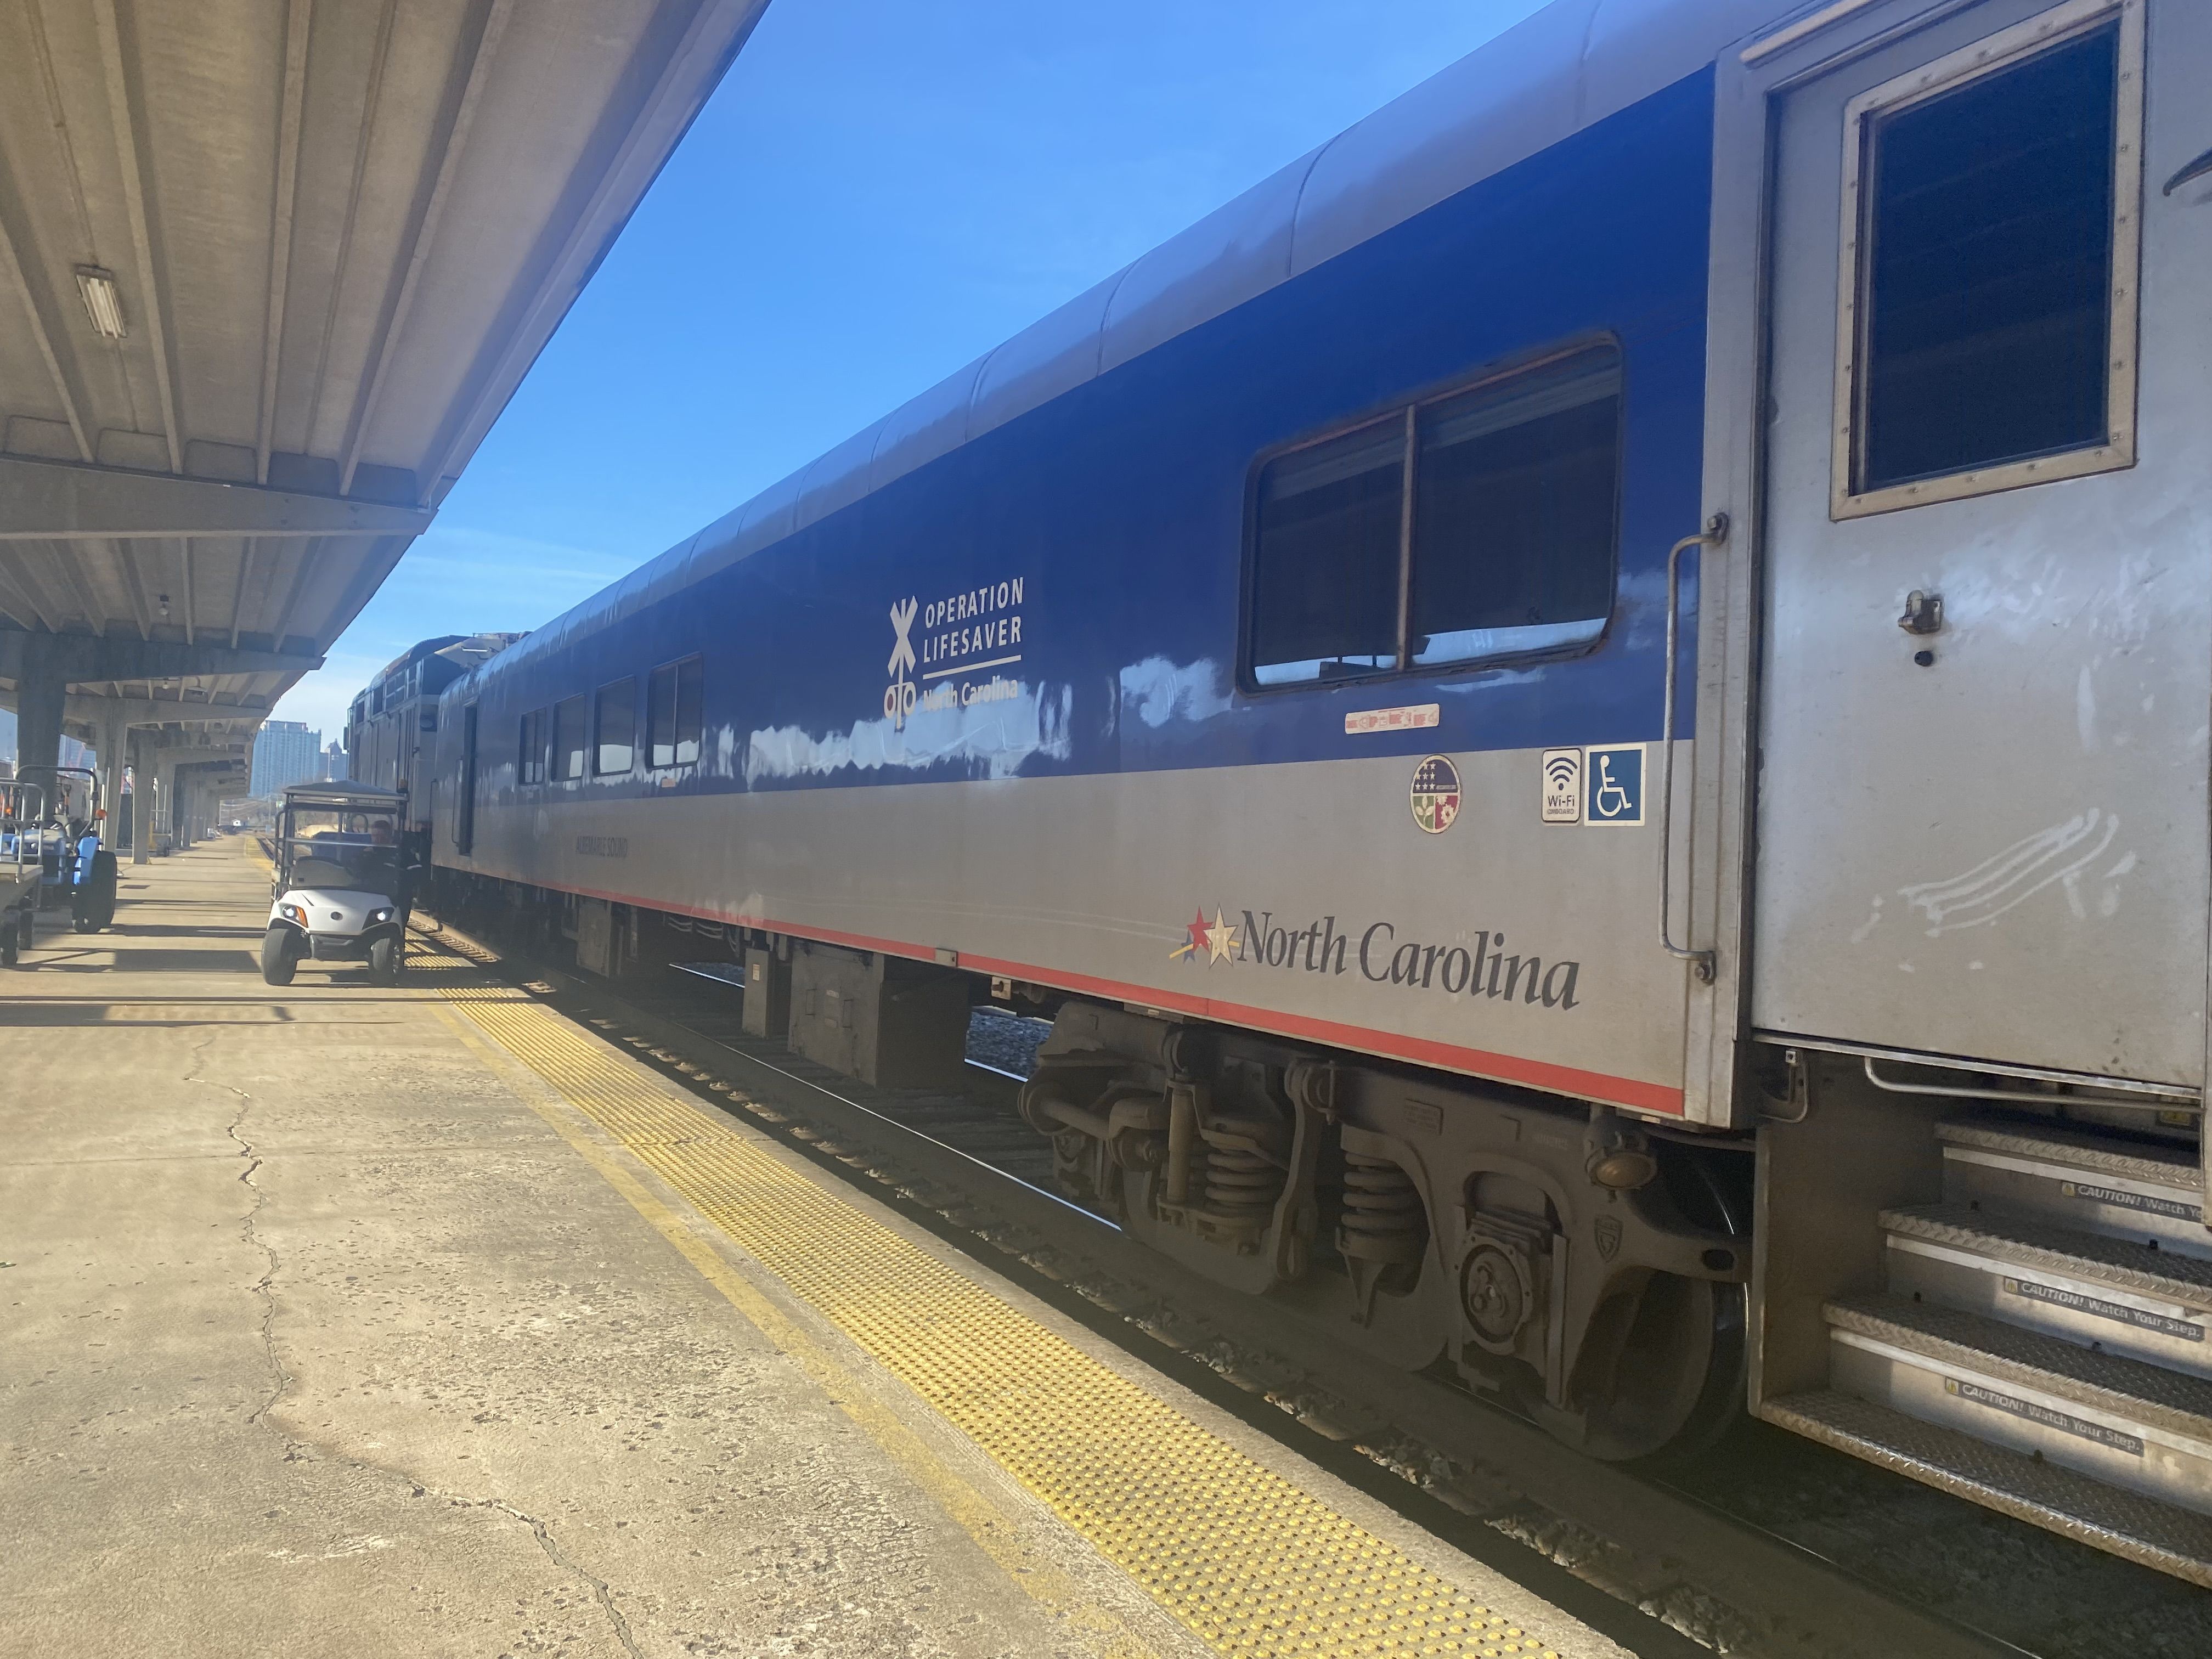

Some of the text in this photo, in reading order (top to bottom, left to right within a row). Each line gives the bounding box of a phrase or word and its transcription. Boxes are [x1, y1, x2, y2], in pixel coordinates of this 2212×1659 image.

[925, 577, 1023, 628] OPERATION
[923, 616, 1022, 663] LIFESAVER
[962, 675, 1018, 706] Carolina
[1548, 795, 1575, 807] Wi-Fi
[607, 837, 628, 858] SOUND
[1237, 910, 1581, 1011] North Carolina
[2077, 1184, 2203, 1218] CAUTION! Watch Yo
[2021, 1282, 2200, 1338] CAUTION! Watch Your Step.
[1962, 1384, 2140, 1451] CAUTION! Watch Your Step.
